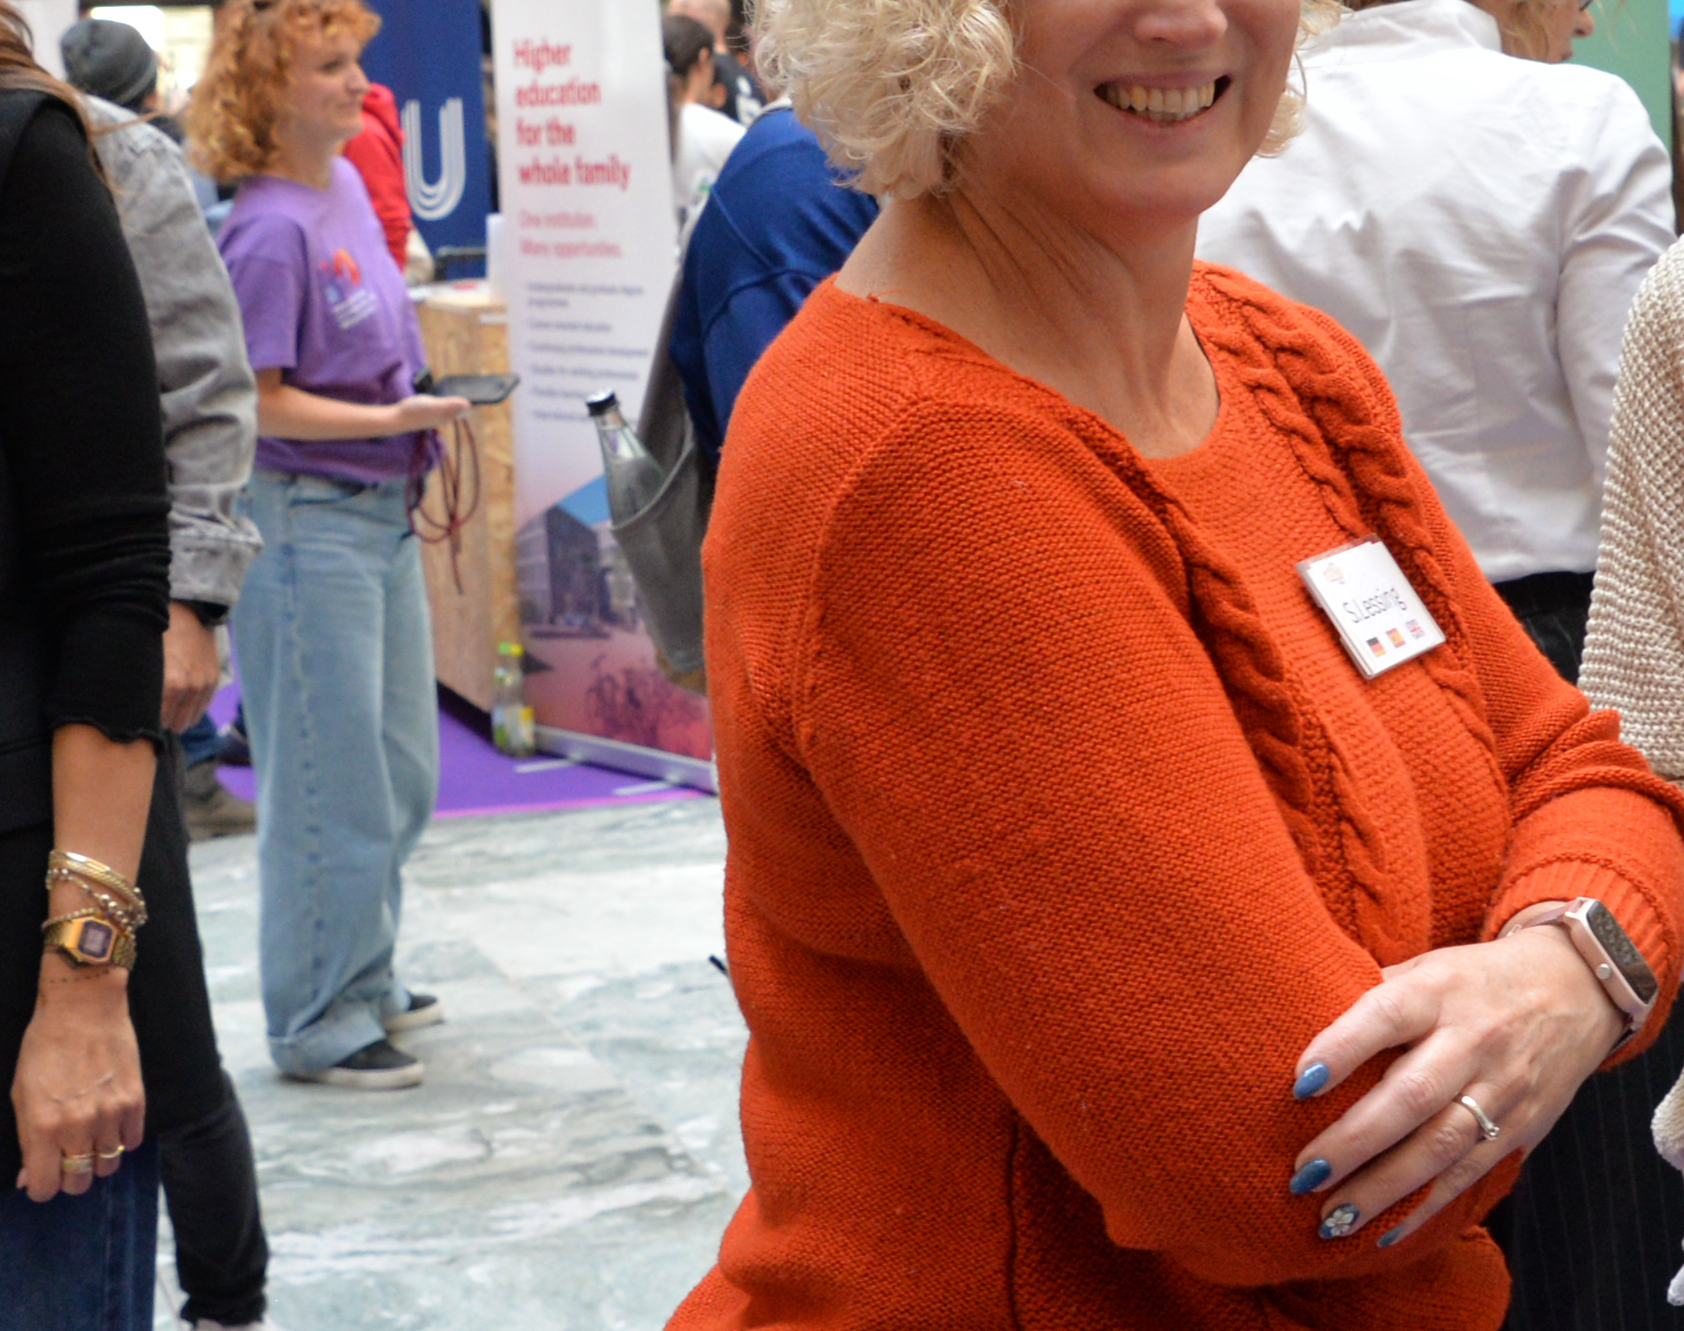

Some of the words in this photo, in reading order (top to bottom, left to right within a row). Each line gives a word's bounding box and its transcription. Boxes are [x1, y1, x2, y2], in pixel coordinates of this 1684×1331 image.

[513, 38, 572, 74] Higher
[515, 78, 601, 108] education
[516, 117, 542, 146] for
[546, 116, 575, 146] the
[519, 155, 572, 187] whole
[575, 154, 631, 192] family
